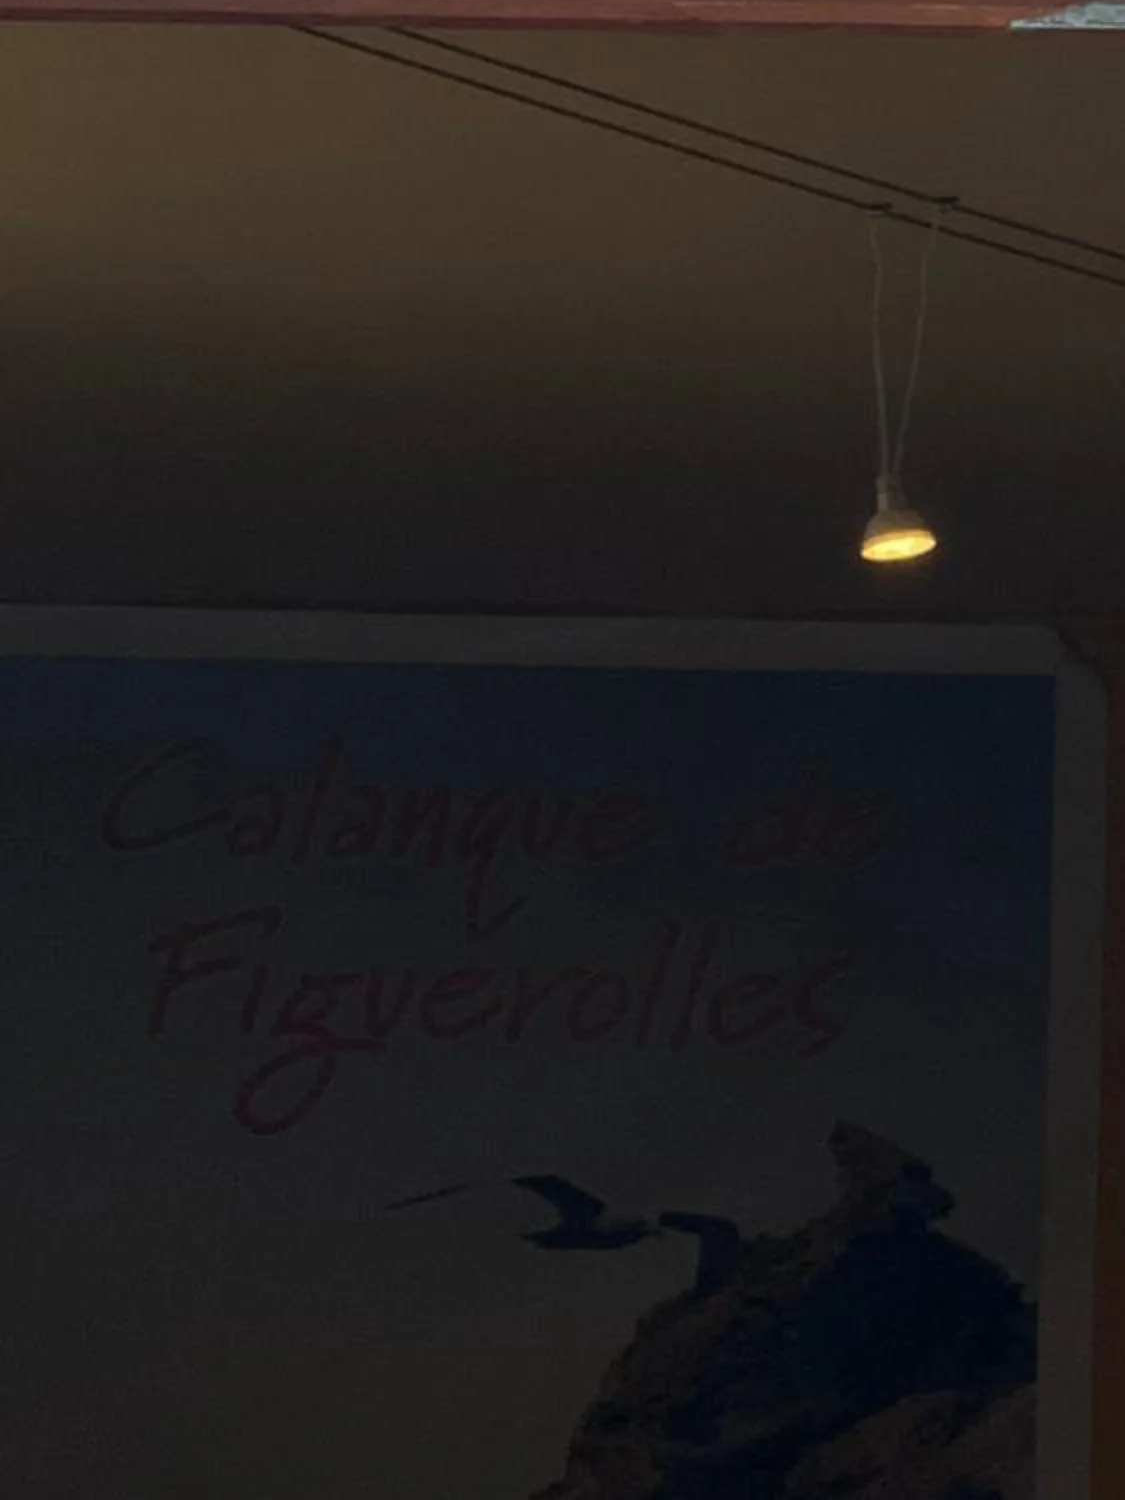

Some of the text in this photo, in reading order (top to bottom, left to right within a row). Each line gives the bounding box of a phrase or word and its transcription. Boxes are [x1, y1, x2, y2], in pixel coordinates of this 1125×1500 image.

[101, 736, 897, 940] Calanque de
[146, 905, 860, 1136] Figuerolles
